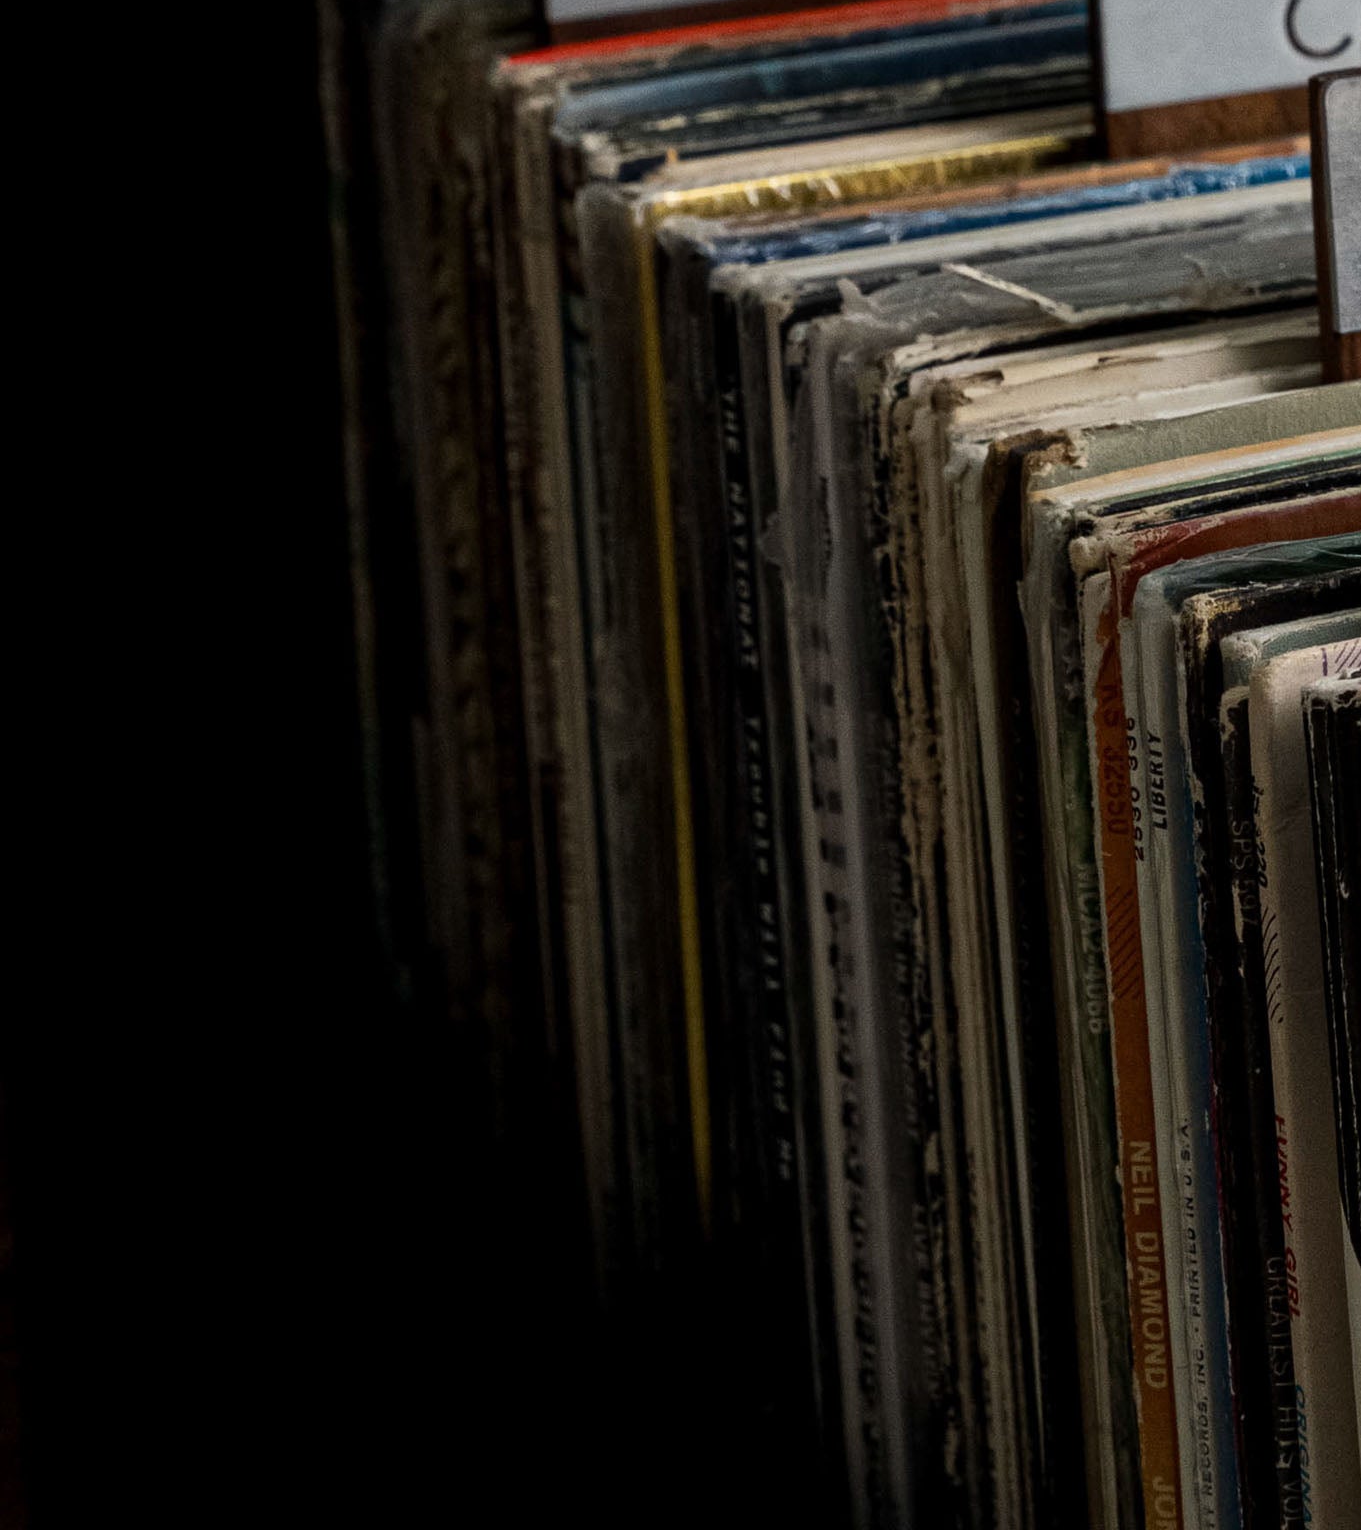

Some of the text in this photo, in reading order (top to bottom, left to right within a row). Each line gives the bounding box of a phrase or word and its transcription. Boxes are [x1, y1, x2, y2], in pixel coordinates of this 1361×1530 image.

[1145, 730, 1167, 831] LIBERTY
[1128, 1140, 1168, 1390] NEIL DIAMOND
[1264, 1256, 1292, 1388] GREATEST
[1275, 1406, 1298, 1469] HITS
